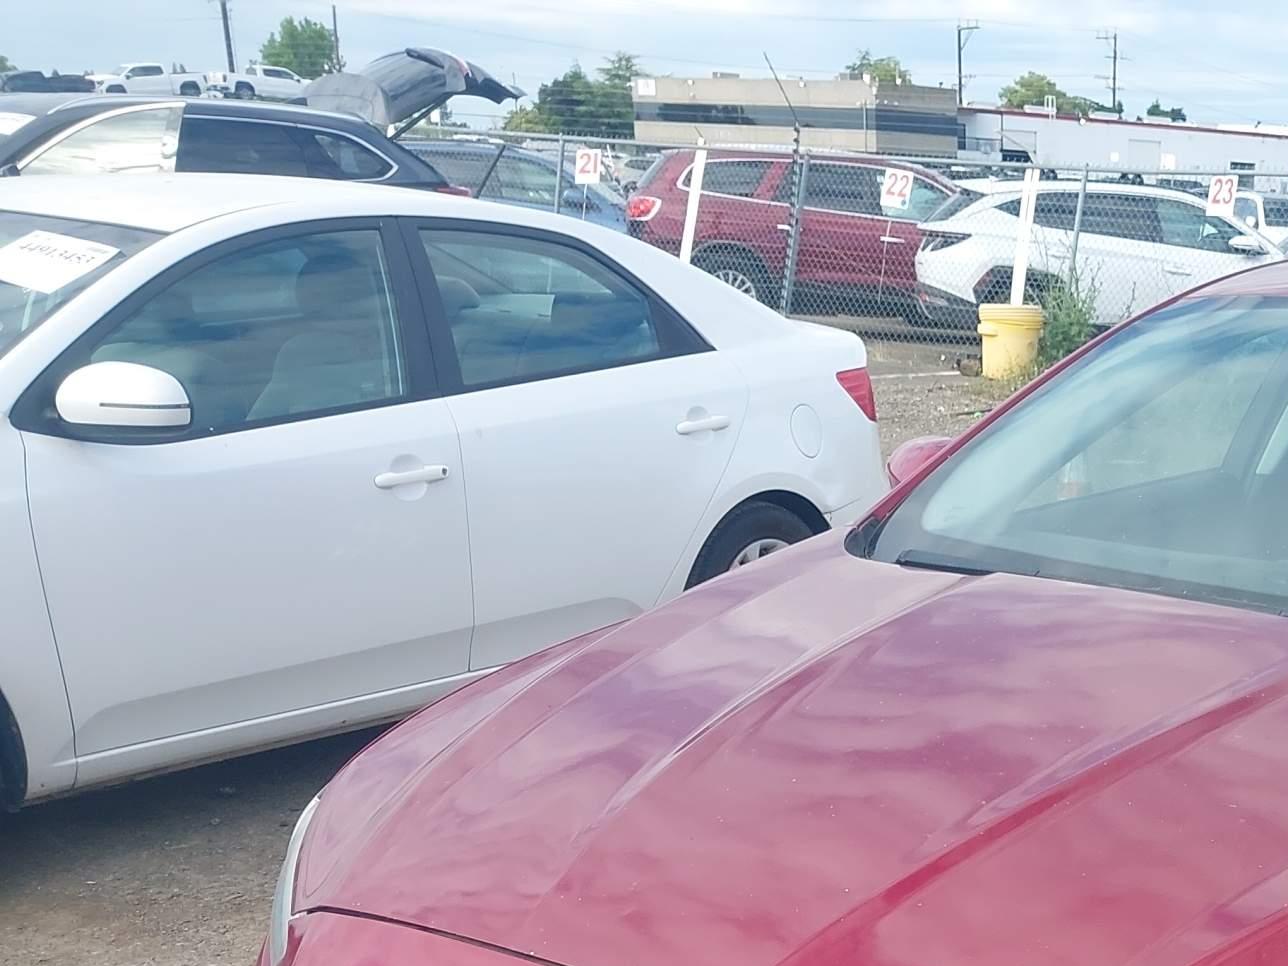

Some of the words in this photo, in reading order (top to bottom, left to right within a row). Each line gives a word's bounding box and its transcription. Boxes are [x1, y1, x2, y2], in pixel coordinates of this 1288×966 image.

[579, 152, 600, 174] 21
[885, 172, 910, 198] 22
[1211, 177, 1235, 205] 23
